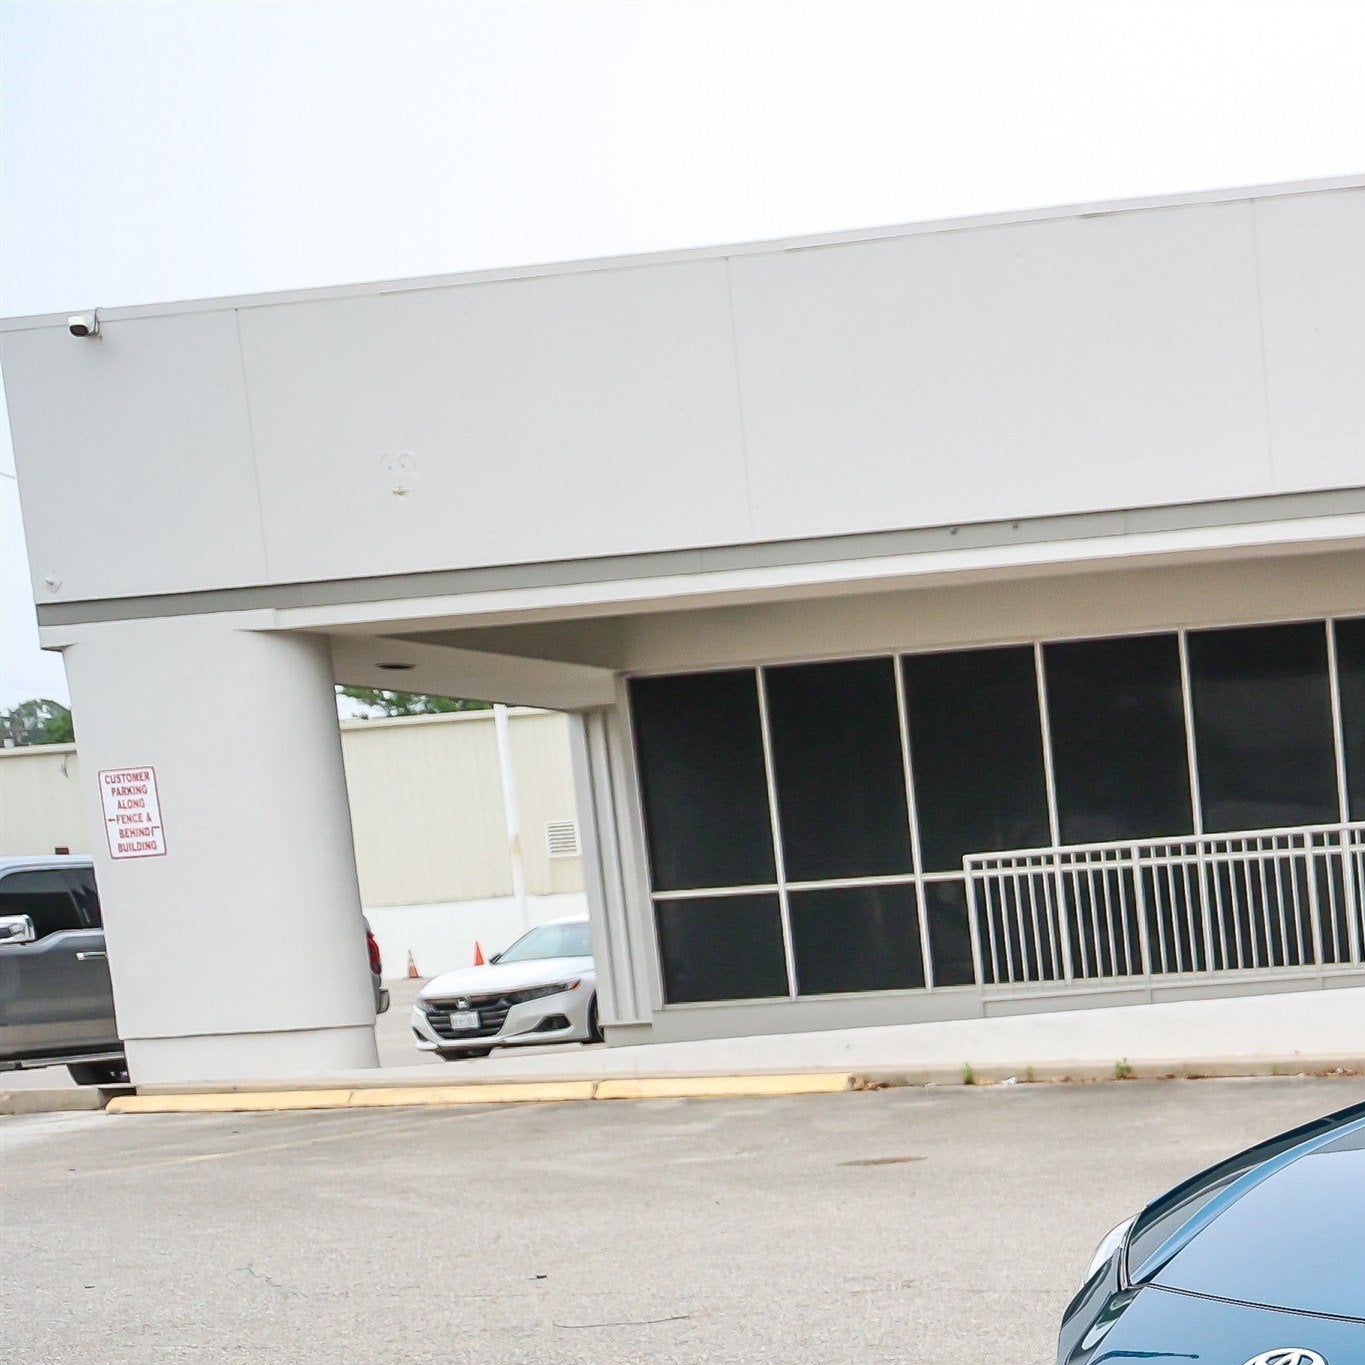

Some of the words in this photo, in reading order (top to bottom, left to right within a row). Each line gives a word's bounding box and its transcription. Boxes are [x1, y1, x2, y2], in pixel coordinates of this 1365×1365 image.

[105, 771, 150, 784] CUSTOMER
[111, 784, 147, 796] PARKING
[117, 798, 145, 809] ALONG
[116, 813, 143, 824] FENCE
[119, 827, 150, 838] BEHIND
[118, 841, 157, 852] BUILDING
